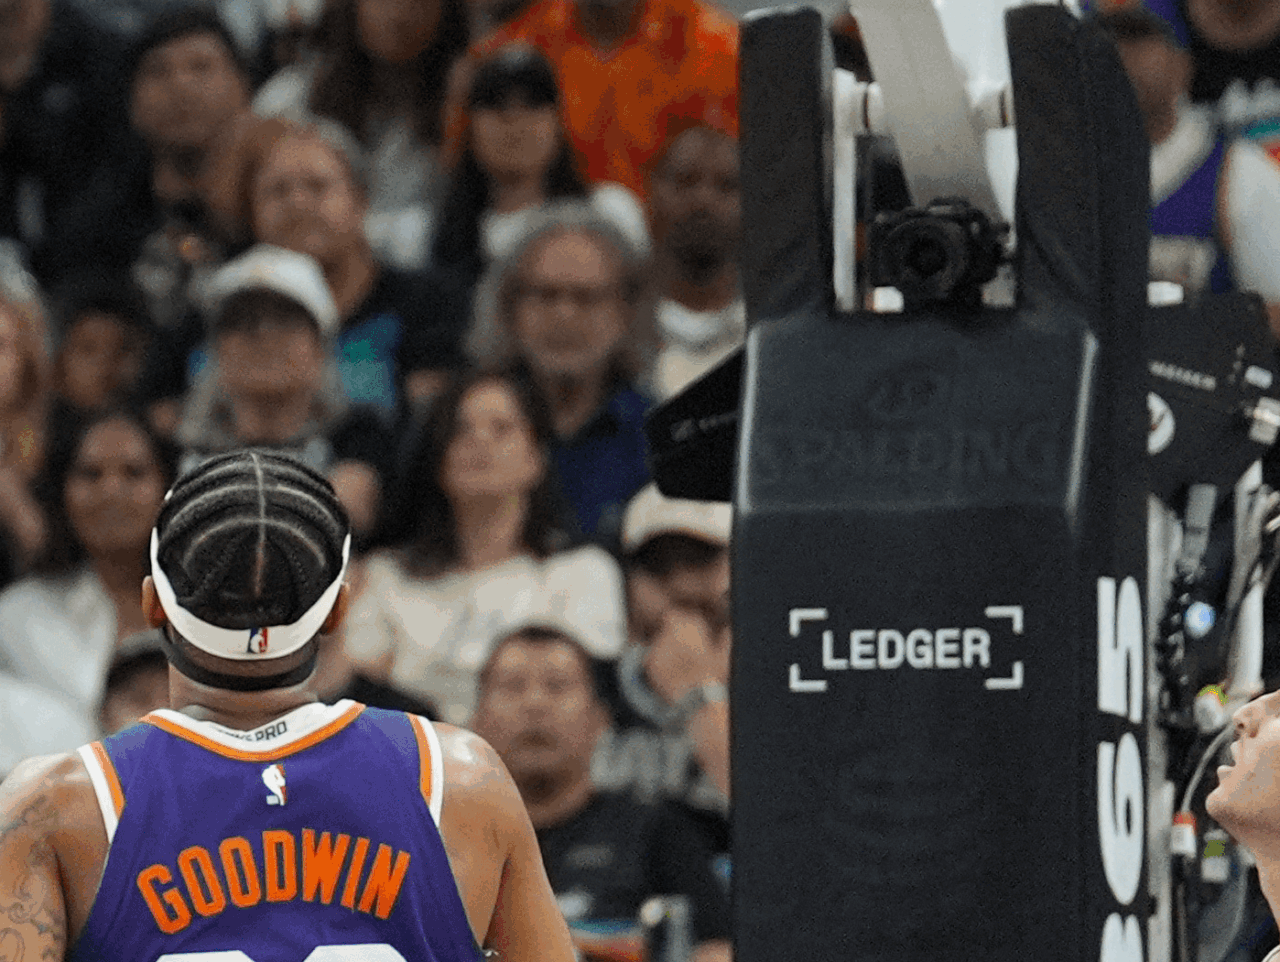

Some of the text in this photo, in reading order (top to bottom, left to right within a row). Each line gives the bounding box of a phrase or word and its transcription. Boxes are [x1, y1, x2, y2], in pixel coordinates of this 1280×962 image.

[822, 627, 991, 670] LEDGER
[255, 720, 288, 742] PRO
[136, 827, 412, 935] GOODWIN
